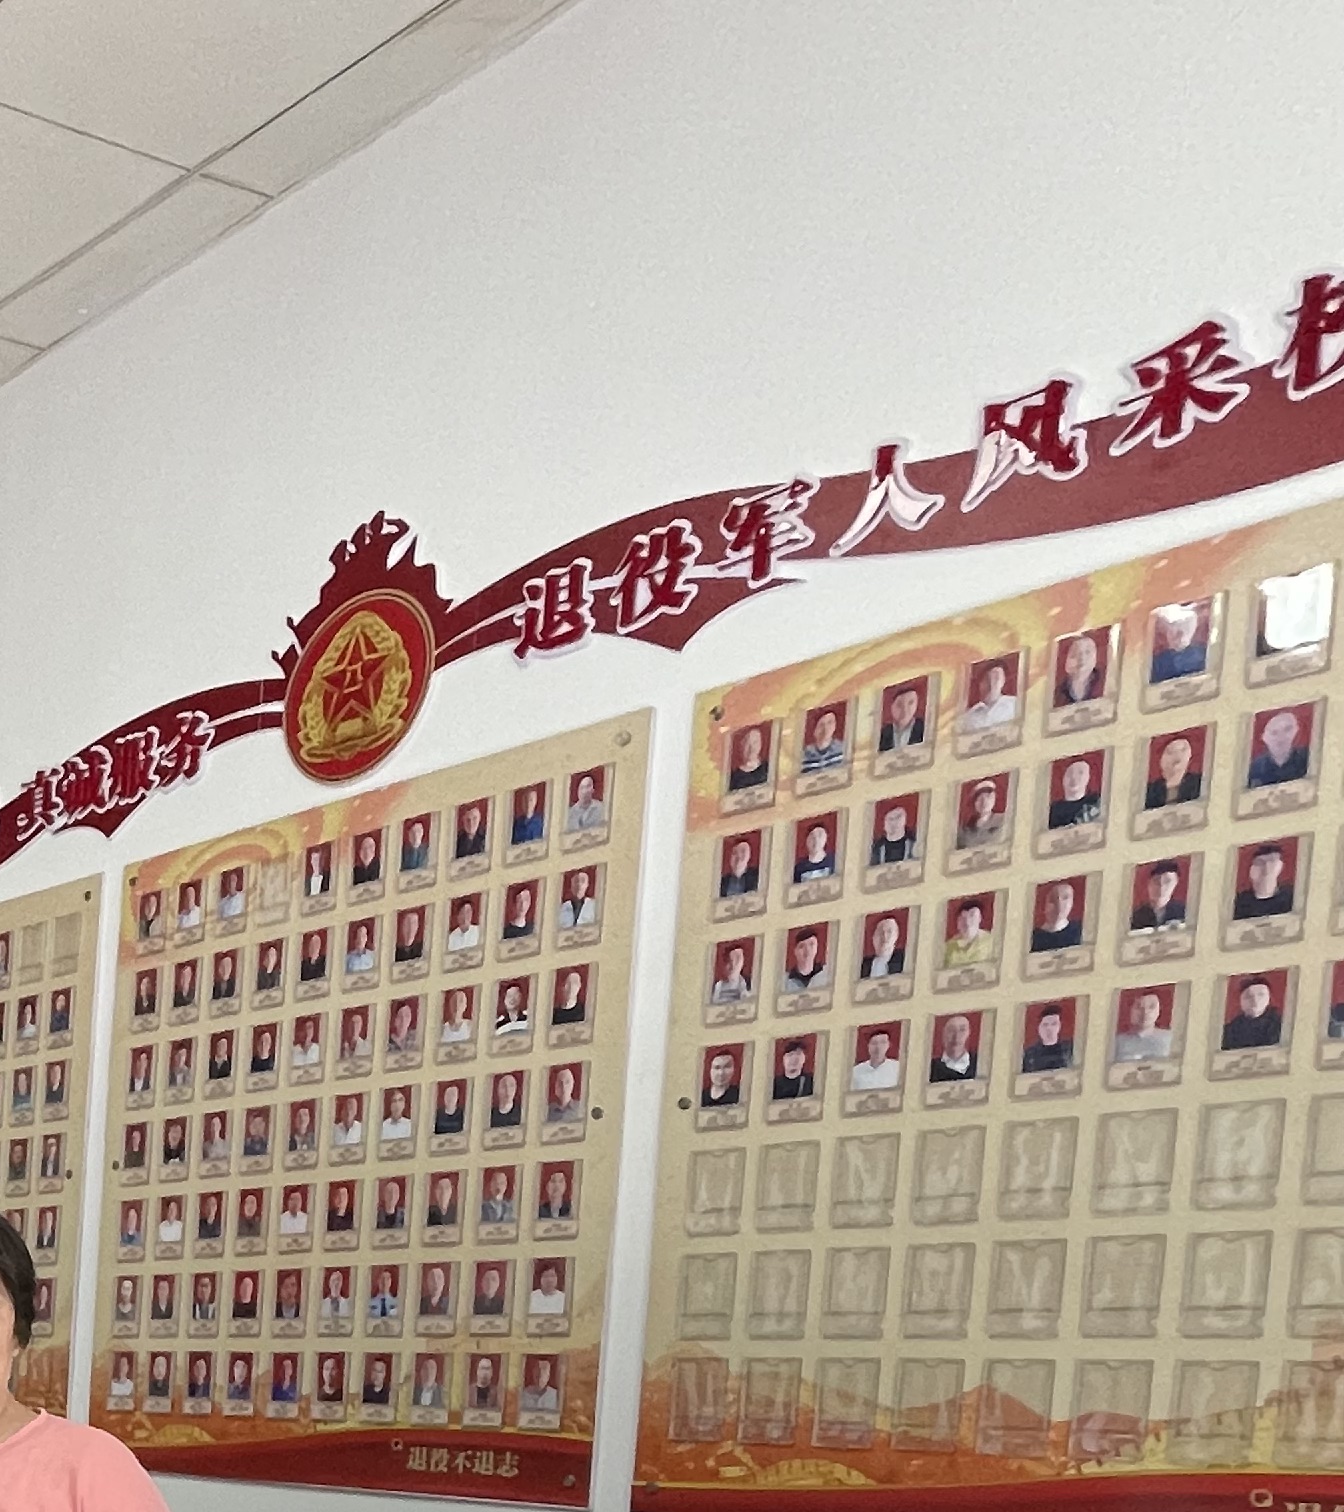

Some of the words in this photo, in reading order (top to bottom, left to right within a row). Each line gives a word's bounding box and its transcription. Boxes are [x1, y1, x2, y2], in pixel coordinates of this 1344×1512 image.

[406, 1446, 520, 1477] 退役不退志
